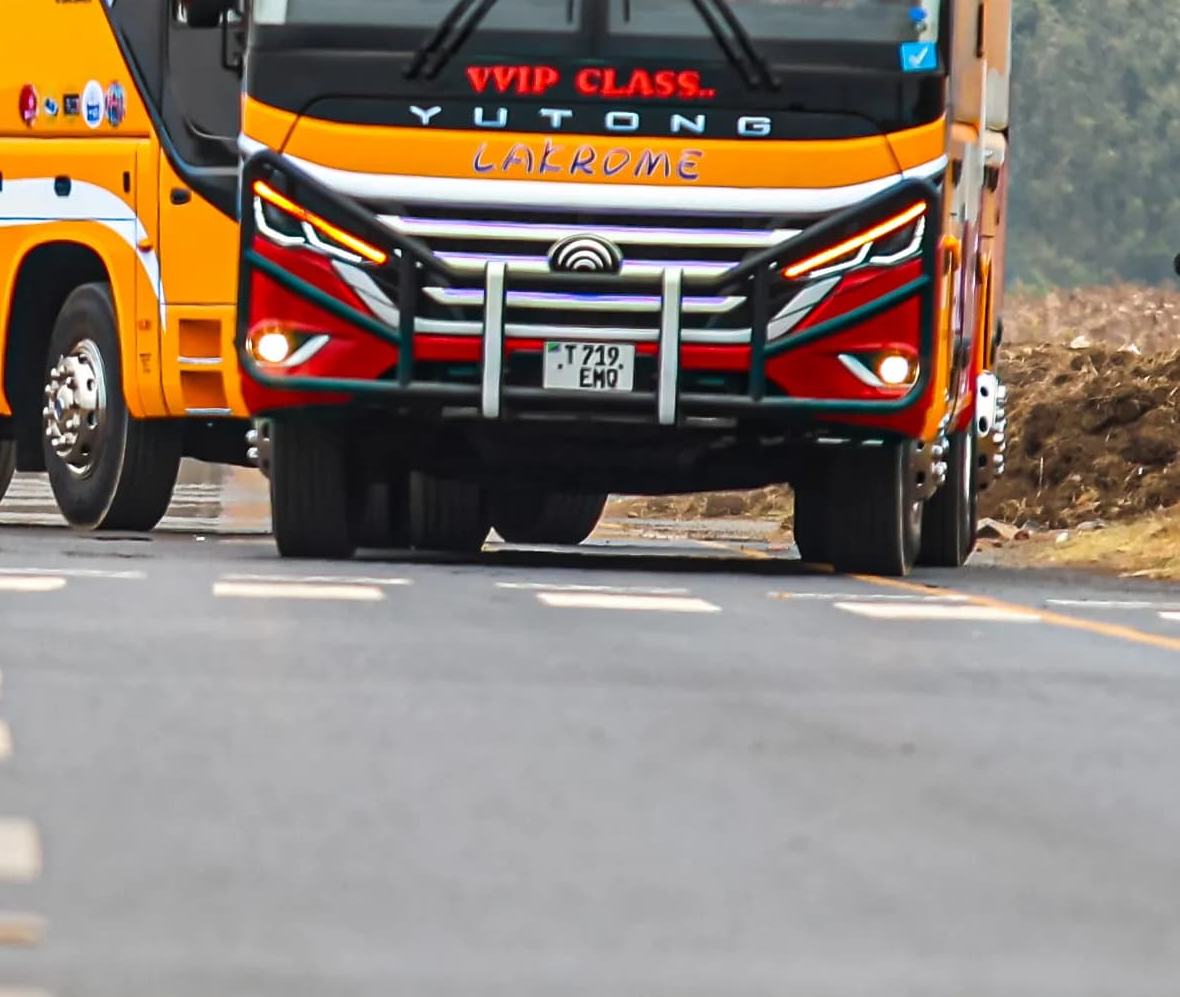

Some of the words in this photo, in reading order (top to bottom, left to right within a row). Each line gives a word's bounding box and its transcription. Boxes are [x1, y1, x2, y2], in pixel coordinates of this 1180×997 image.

[467, 66, 559, 94] VVIP
[409, 105, 772, 136] YUTONG
[473, 138, 703, 181] LAKROME
[564, 344, 577, 365] T
[582, 344, 619, 366] 719
